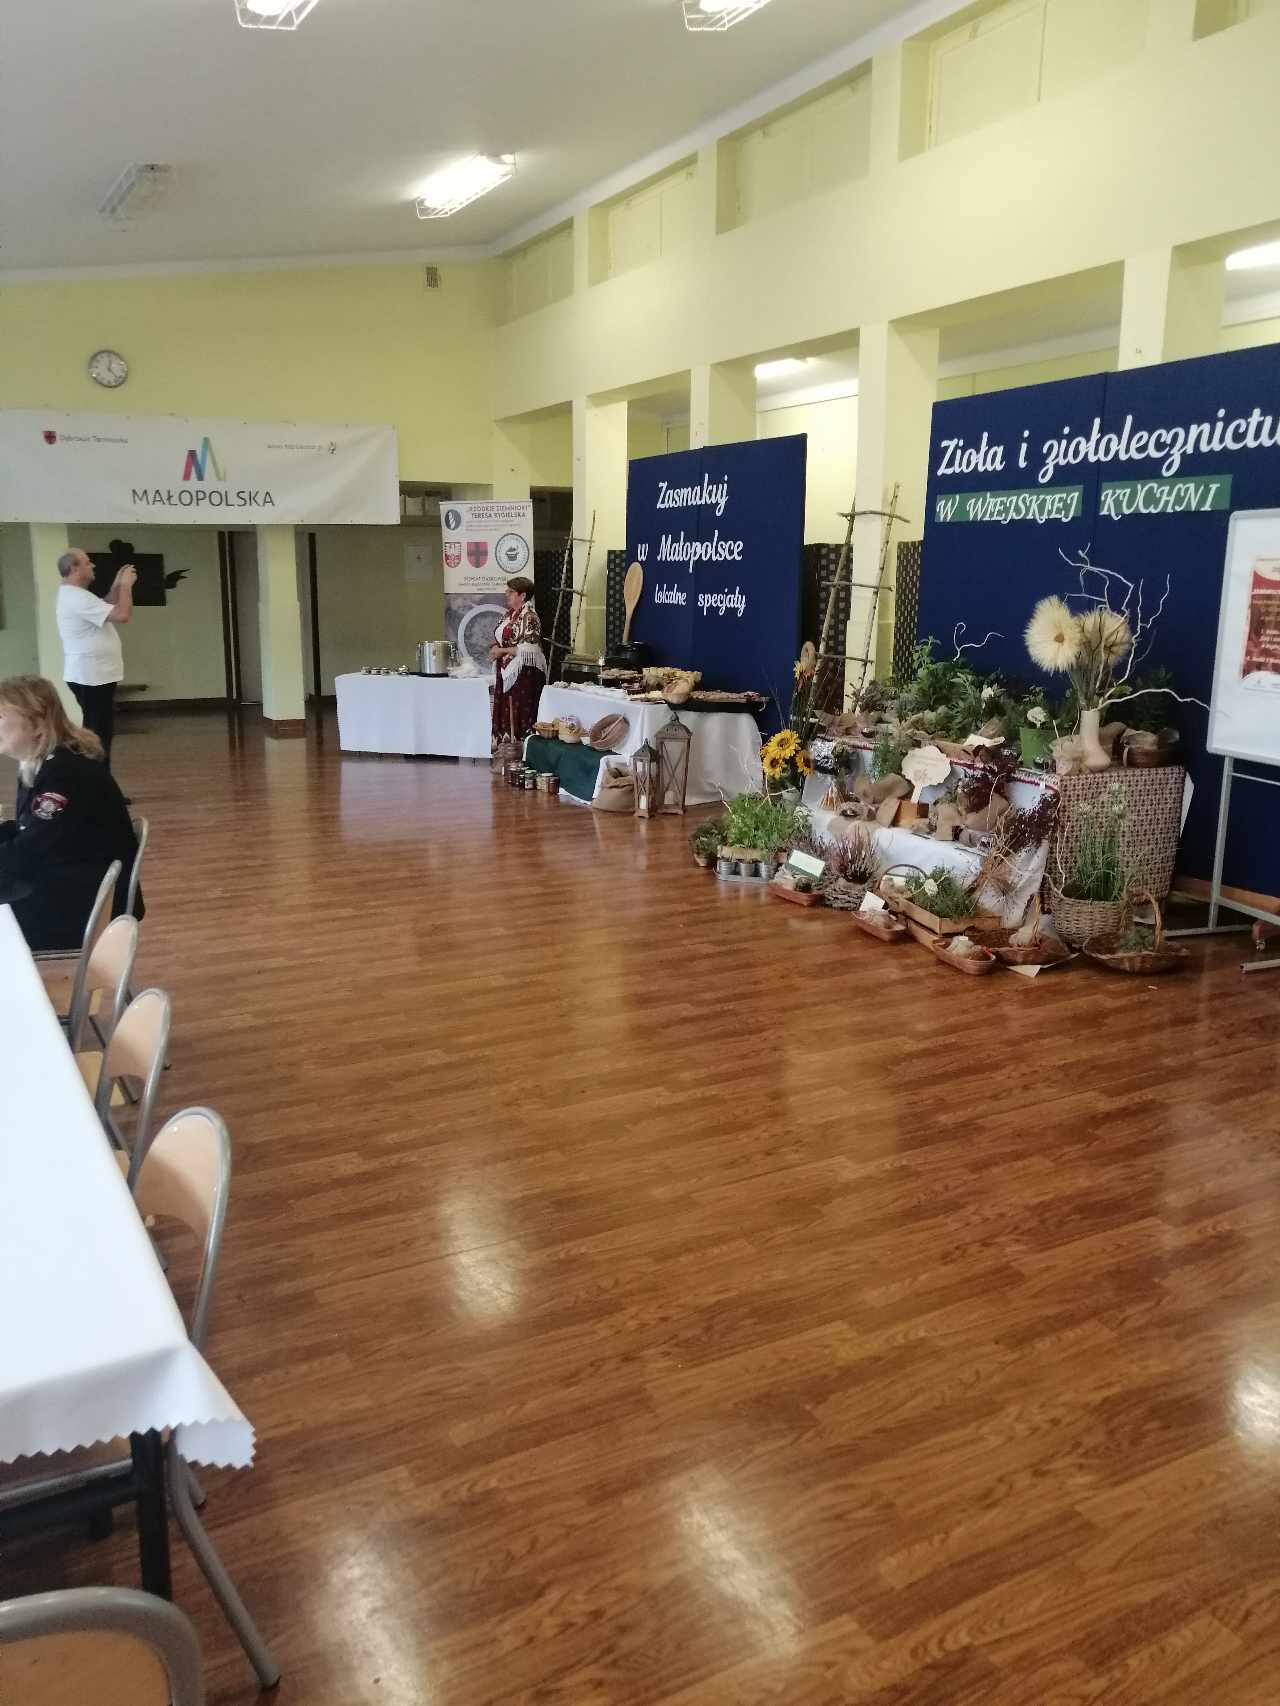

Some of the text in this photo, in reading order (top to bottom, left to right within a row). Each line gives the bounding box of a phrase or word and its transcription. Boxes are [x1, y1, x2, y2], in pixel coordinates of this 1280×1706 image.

[936, 432, 1006, 477] Zioła
[1018, 430, 1030, 469] i
[131, 488, 275, 508] MAŁOPOLSKA
[656, 473, 728, 515] Zasmakuj
[936, 483, 1221, 525] W WIEJSKIEJ KUCHNI
[637, 529, 743, 573] w Małopolsce
[655, 584, 746, 617] lokalne specjały
